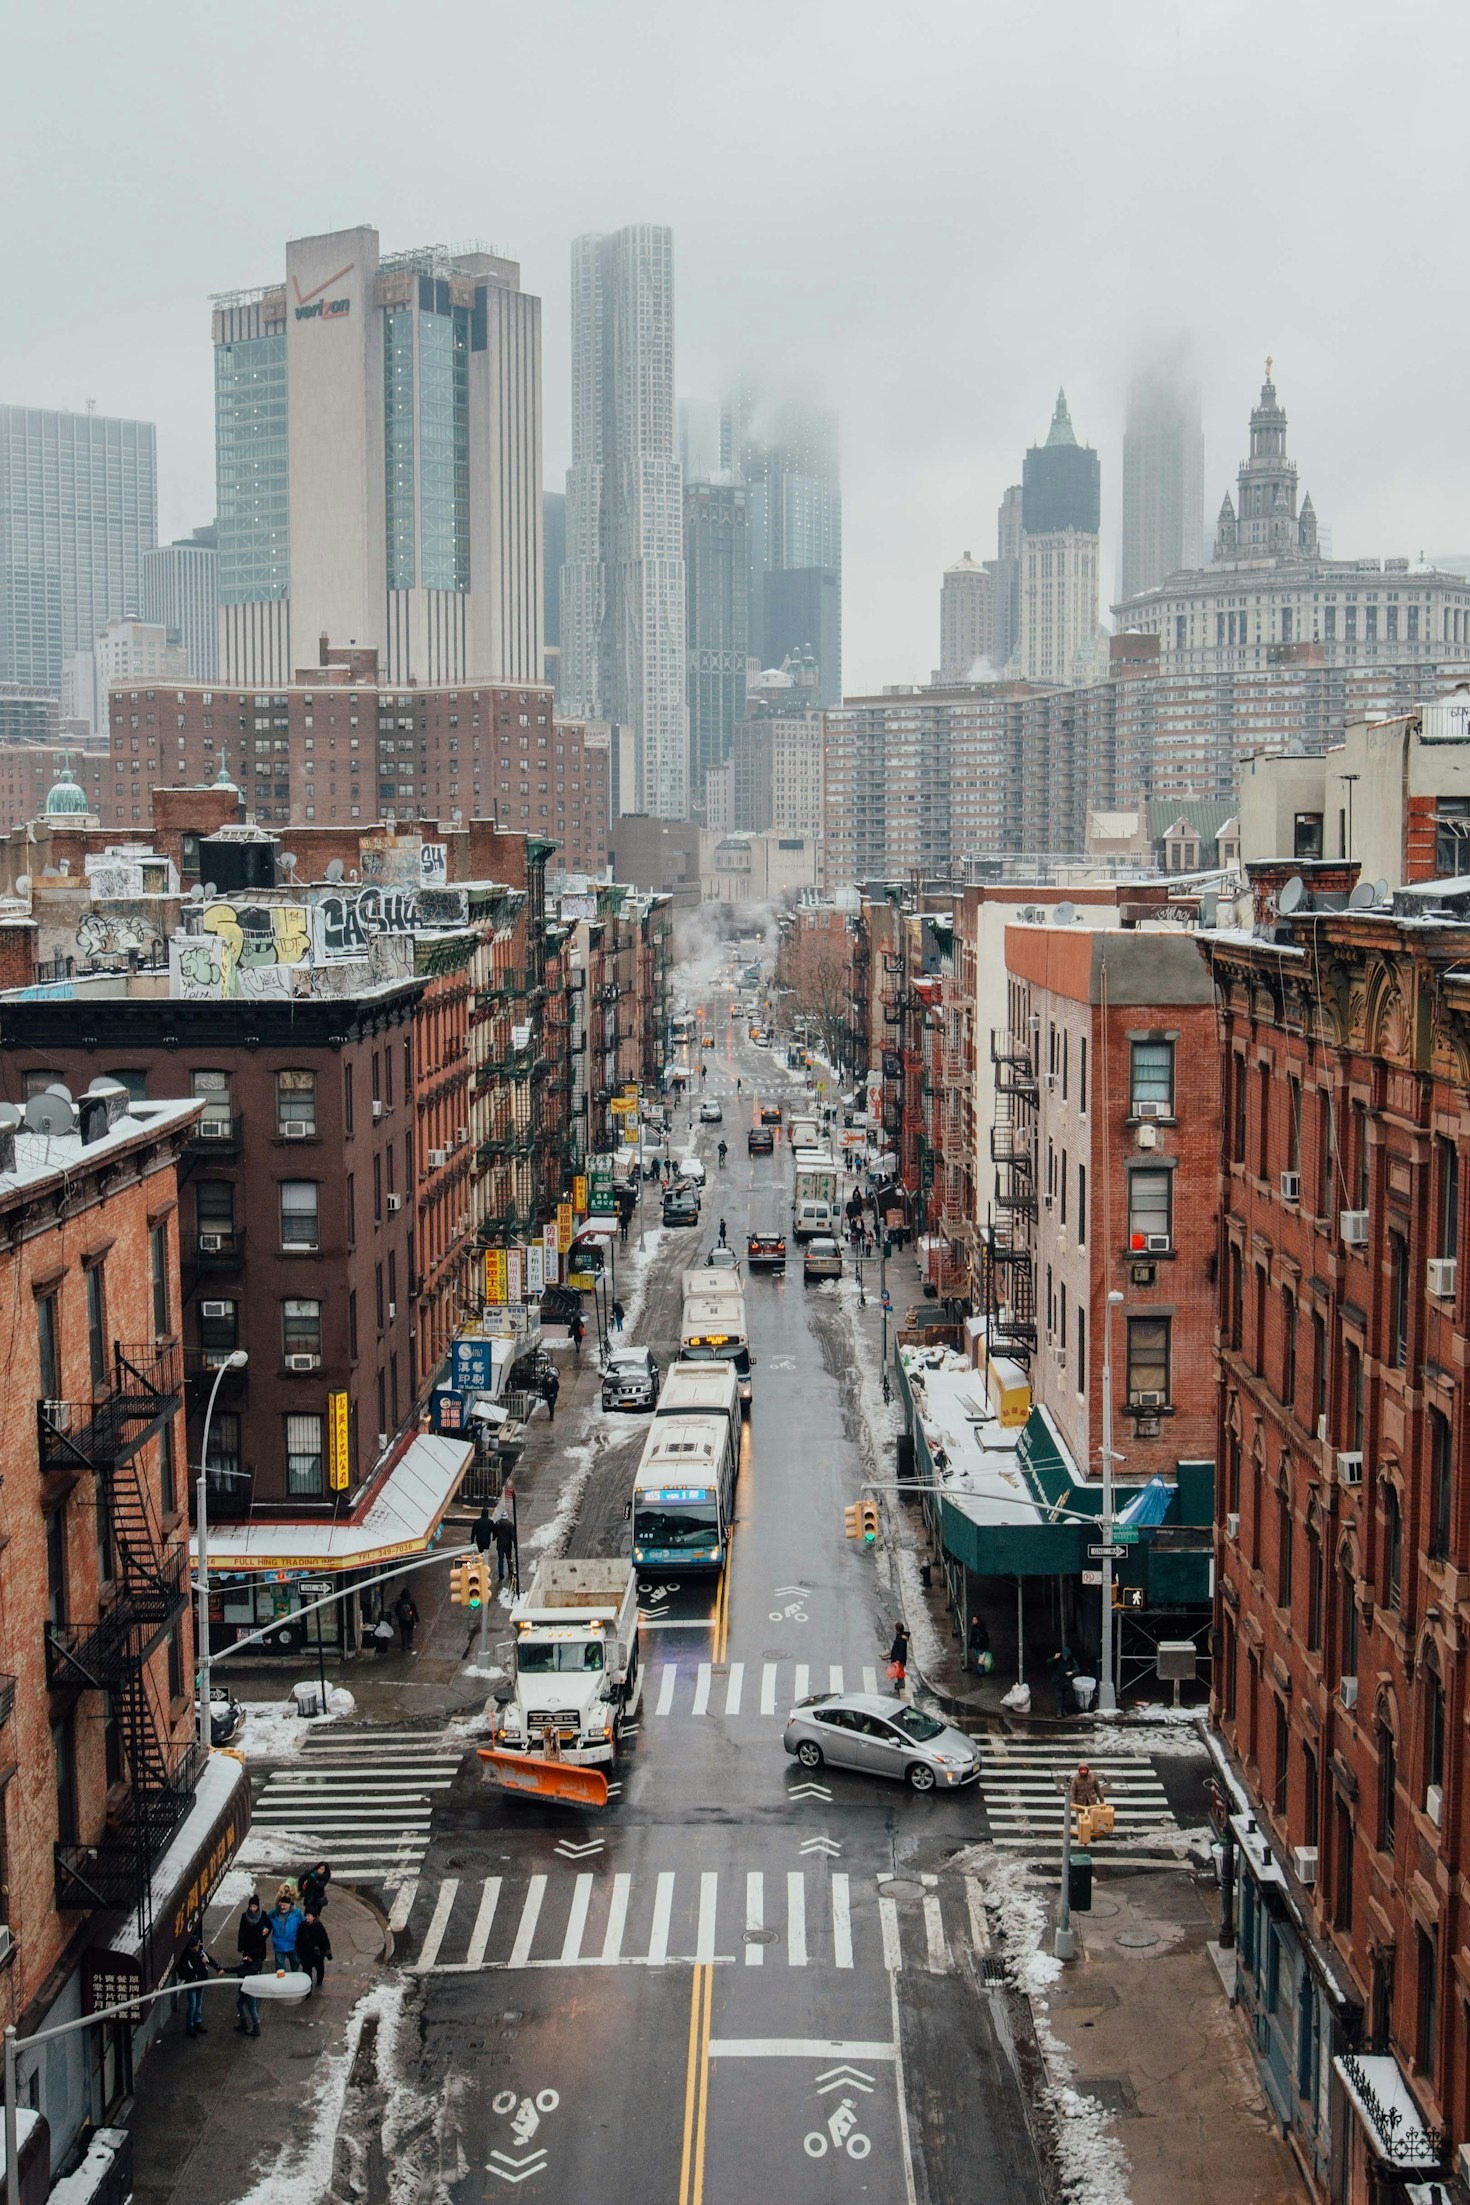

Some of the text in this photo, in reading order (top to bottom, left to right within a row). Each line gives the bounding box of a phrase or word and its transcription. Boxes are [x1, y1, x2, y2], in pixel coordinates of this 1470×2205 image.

[295, 298, 350, 320] verizon
[378, 1543, 413, 1558] 349-7036
[234, 1558, 255, 1566] FULL
[257, 1558, 278, 1566] HING
[281, 1558, 319, 1566] TRADING
[206, 1852, 234, 1903] PRINTING
